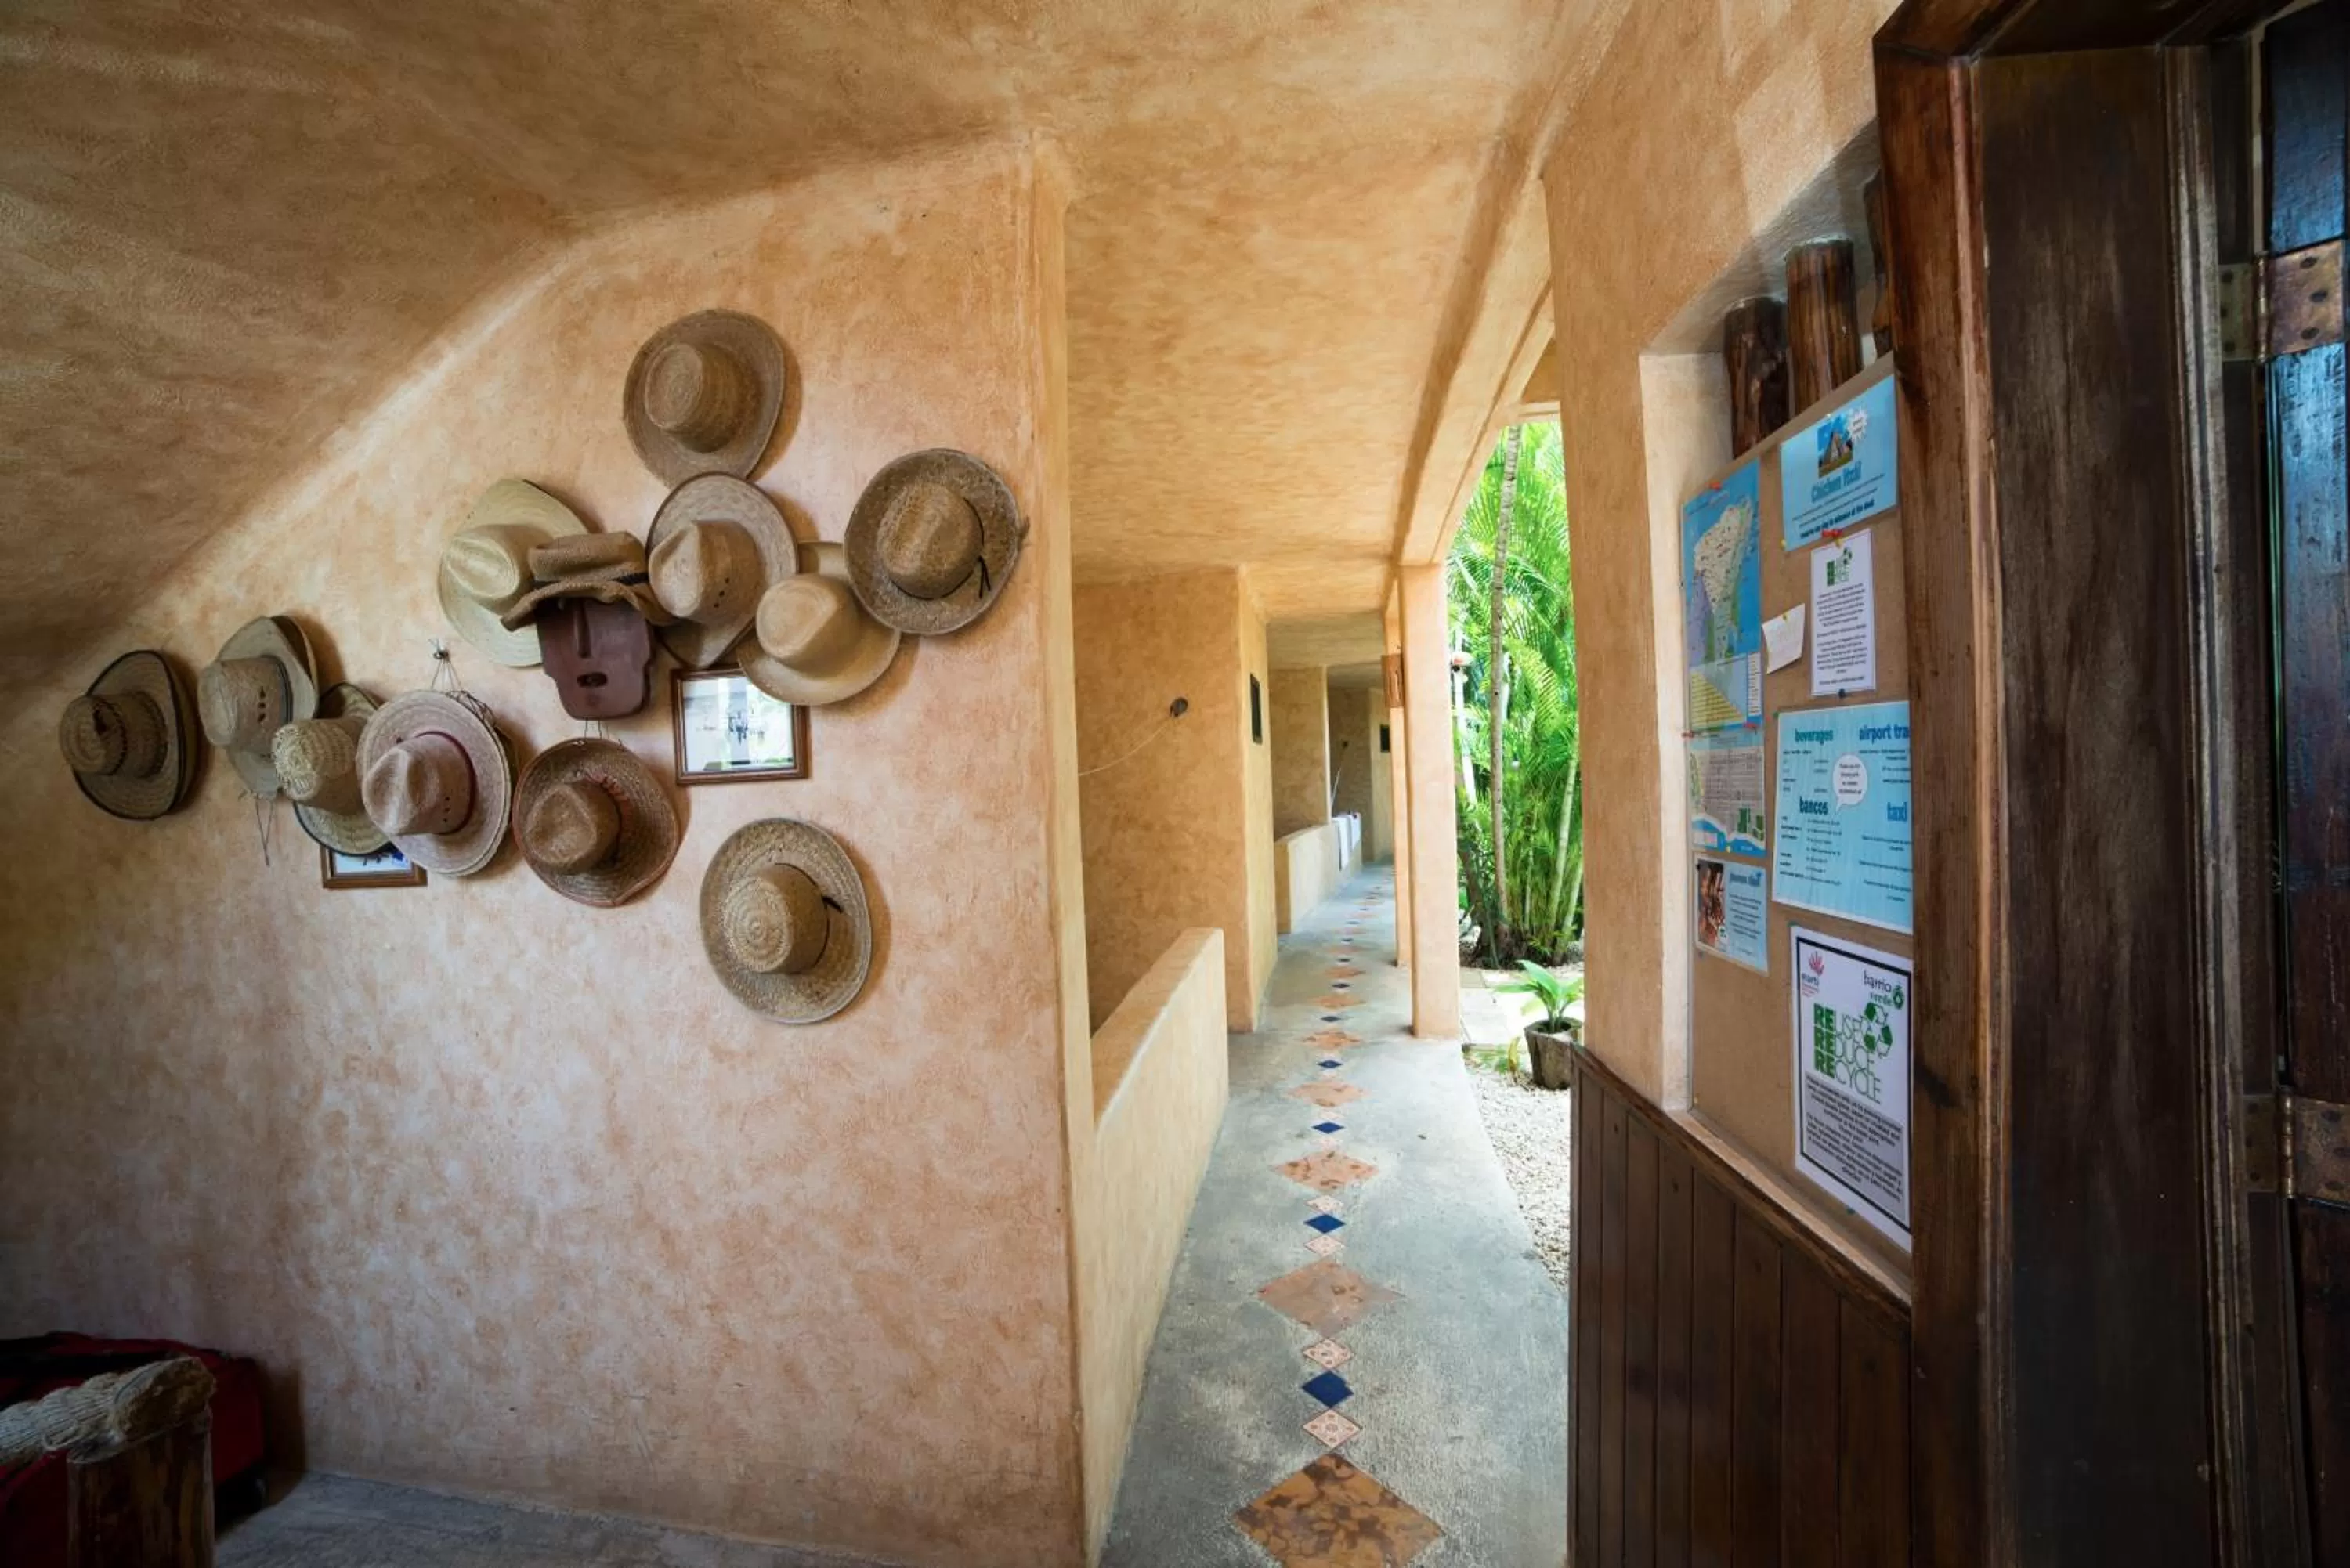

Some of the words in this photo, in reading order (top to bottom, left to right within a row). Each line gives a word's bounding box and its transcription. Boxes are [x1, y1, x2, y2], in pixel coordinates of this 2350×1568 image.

[1795, 728, 1833, 746] beverages
[1859, 724, 1892, 745] airport
[1799, 796, 1828, 815] bancos
[1864, 970, 1892, 993] barrio
